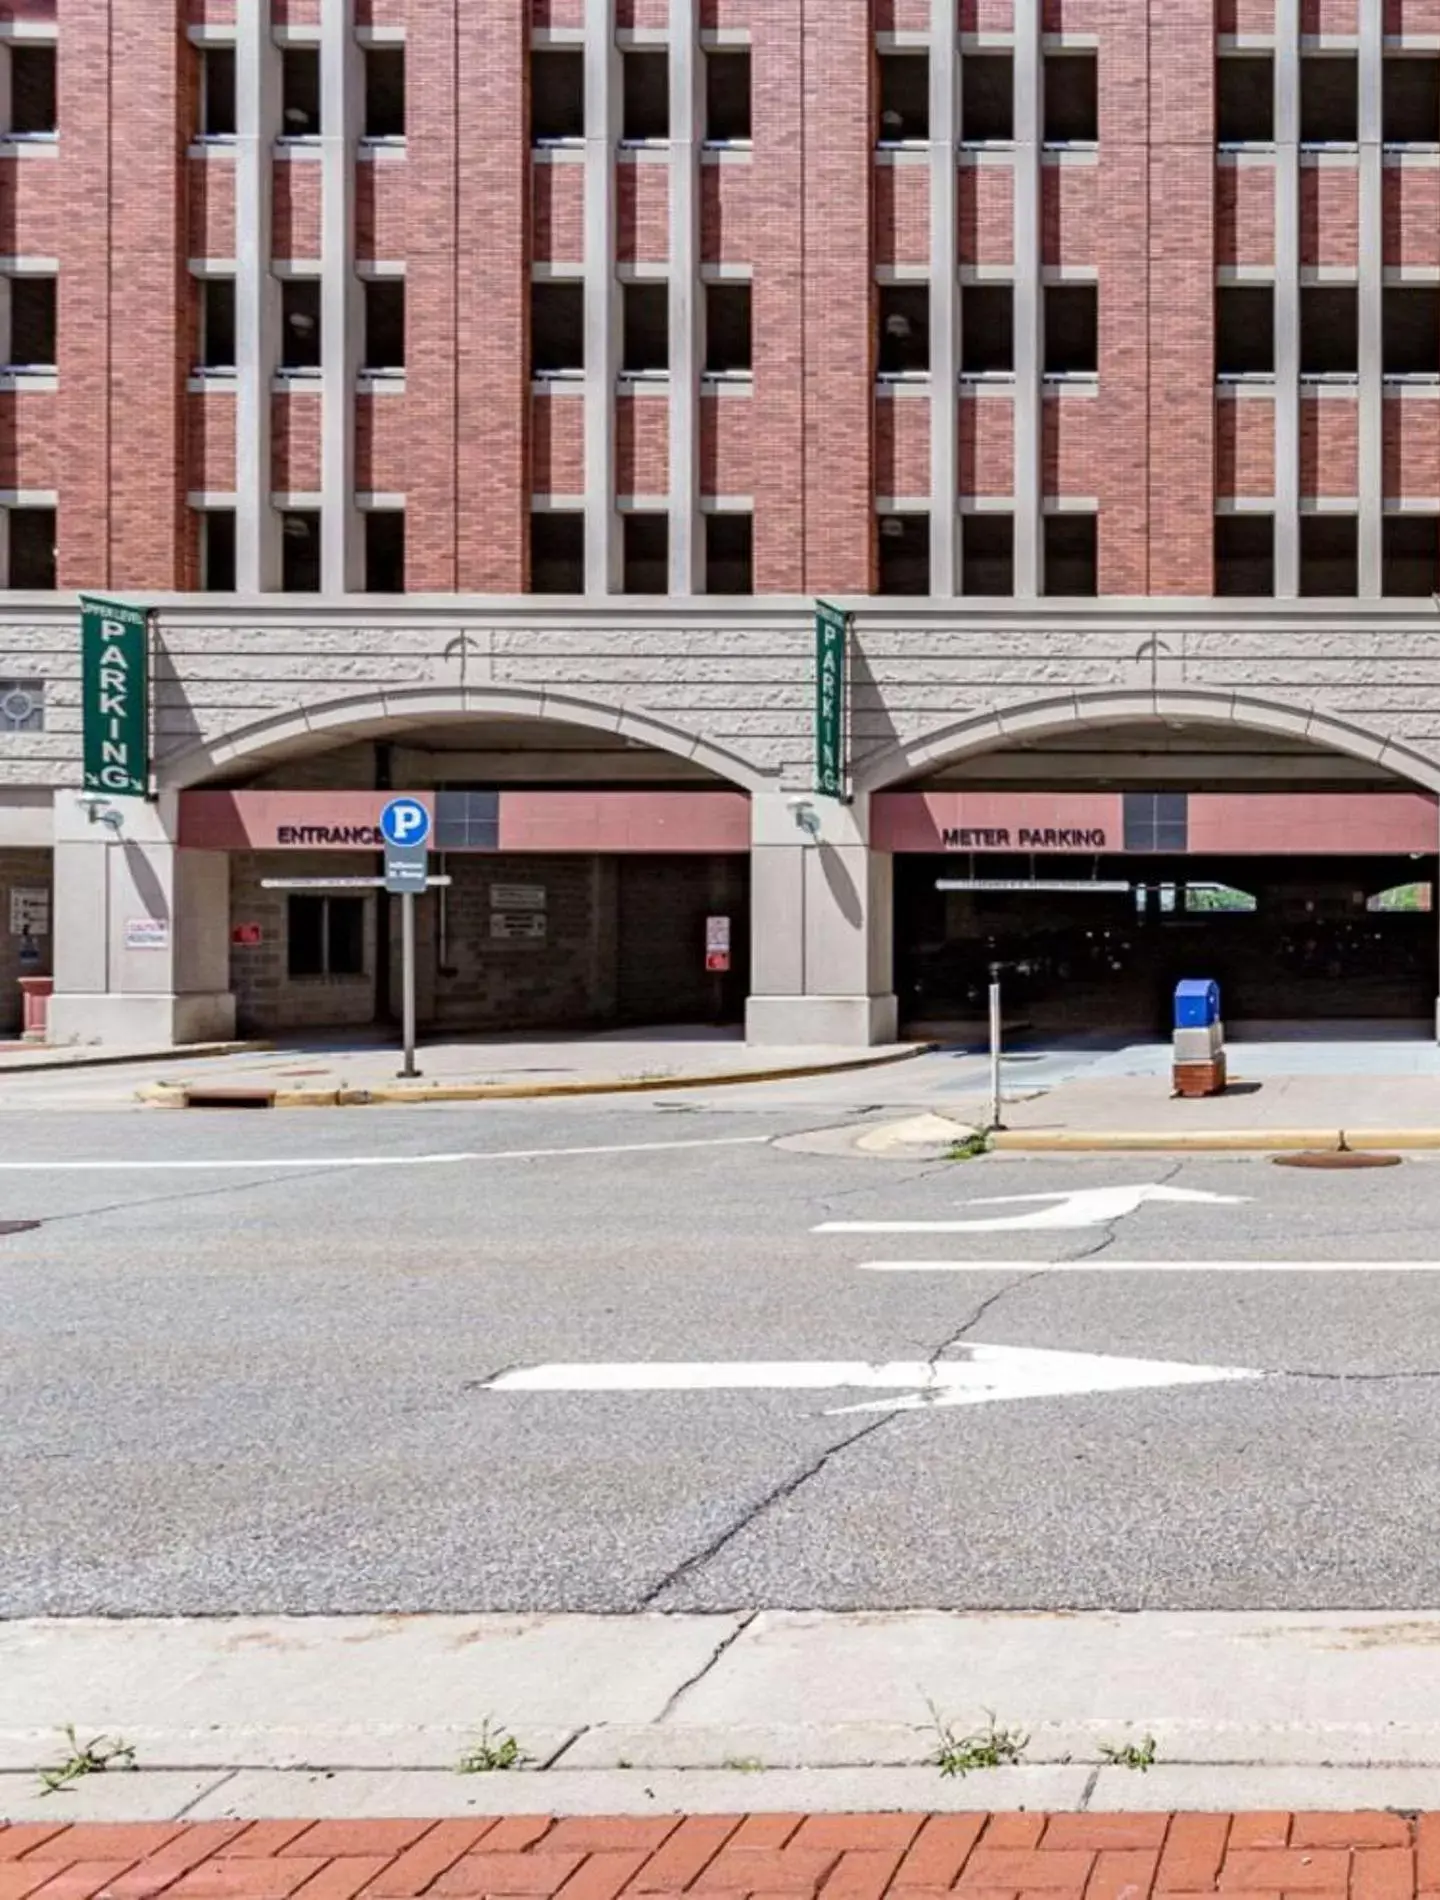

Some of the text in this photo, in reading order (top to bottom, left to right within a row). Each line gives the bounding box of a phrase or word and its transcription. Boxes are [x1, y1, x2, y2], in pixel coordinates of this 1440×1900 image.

[100, 620, 129, 788] PARKING
[822, 624, 837, 791] PARKING
[394, 806, 421, 838] P
[942, 828, 1106, 847] METER PARKING
